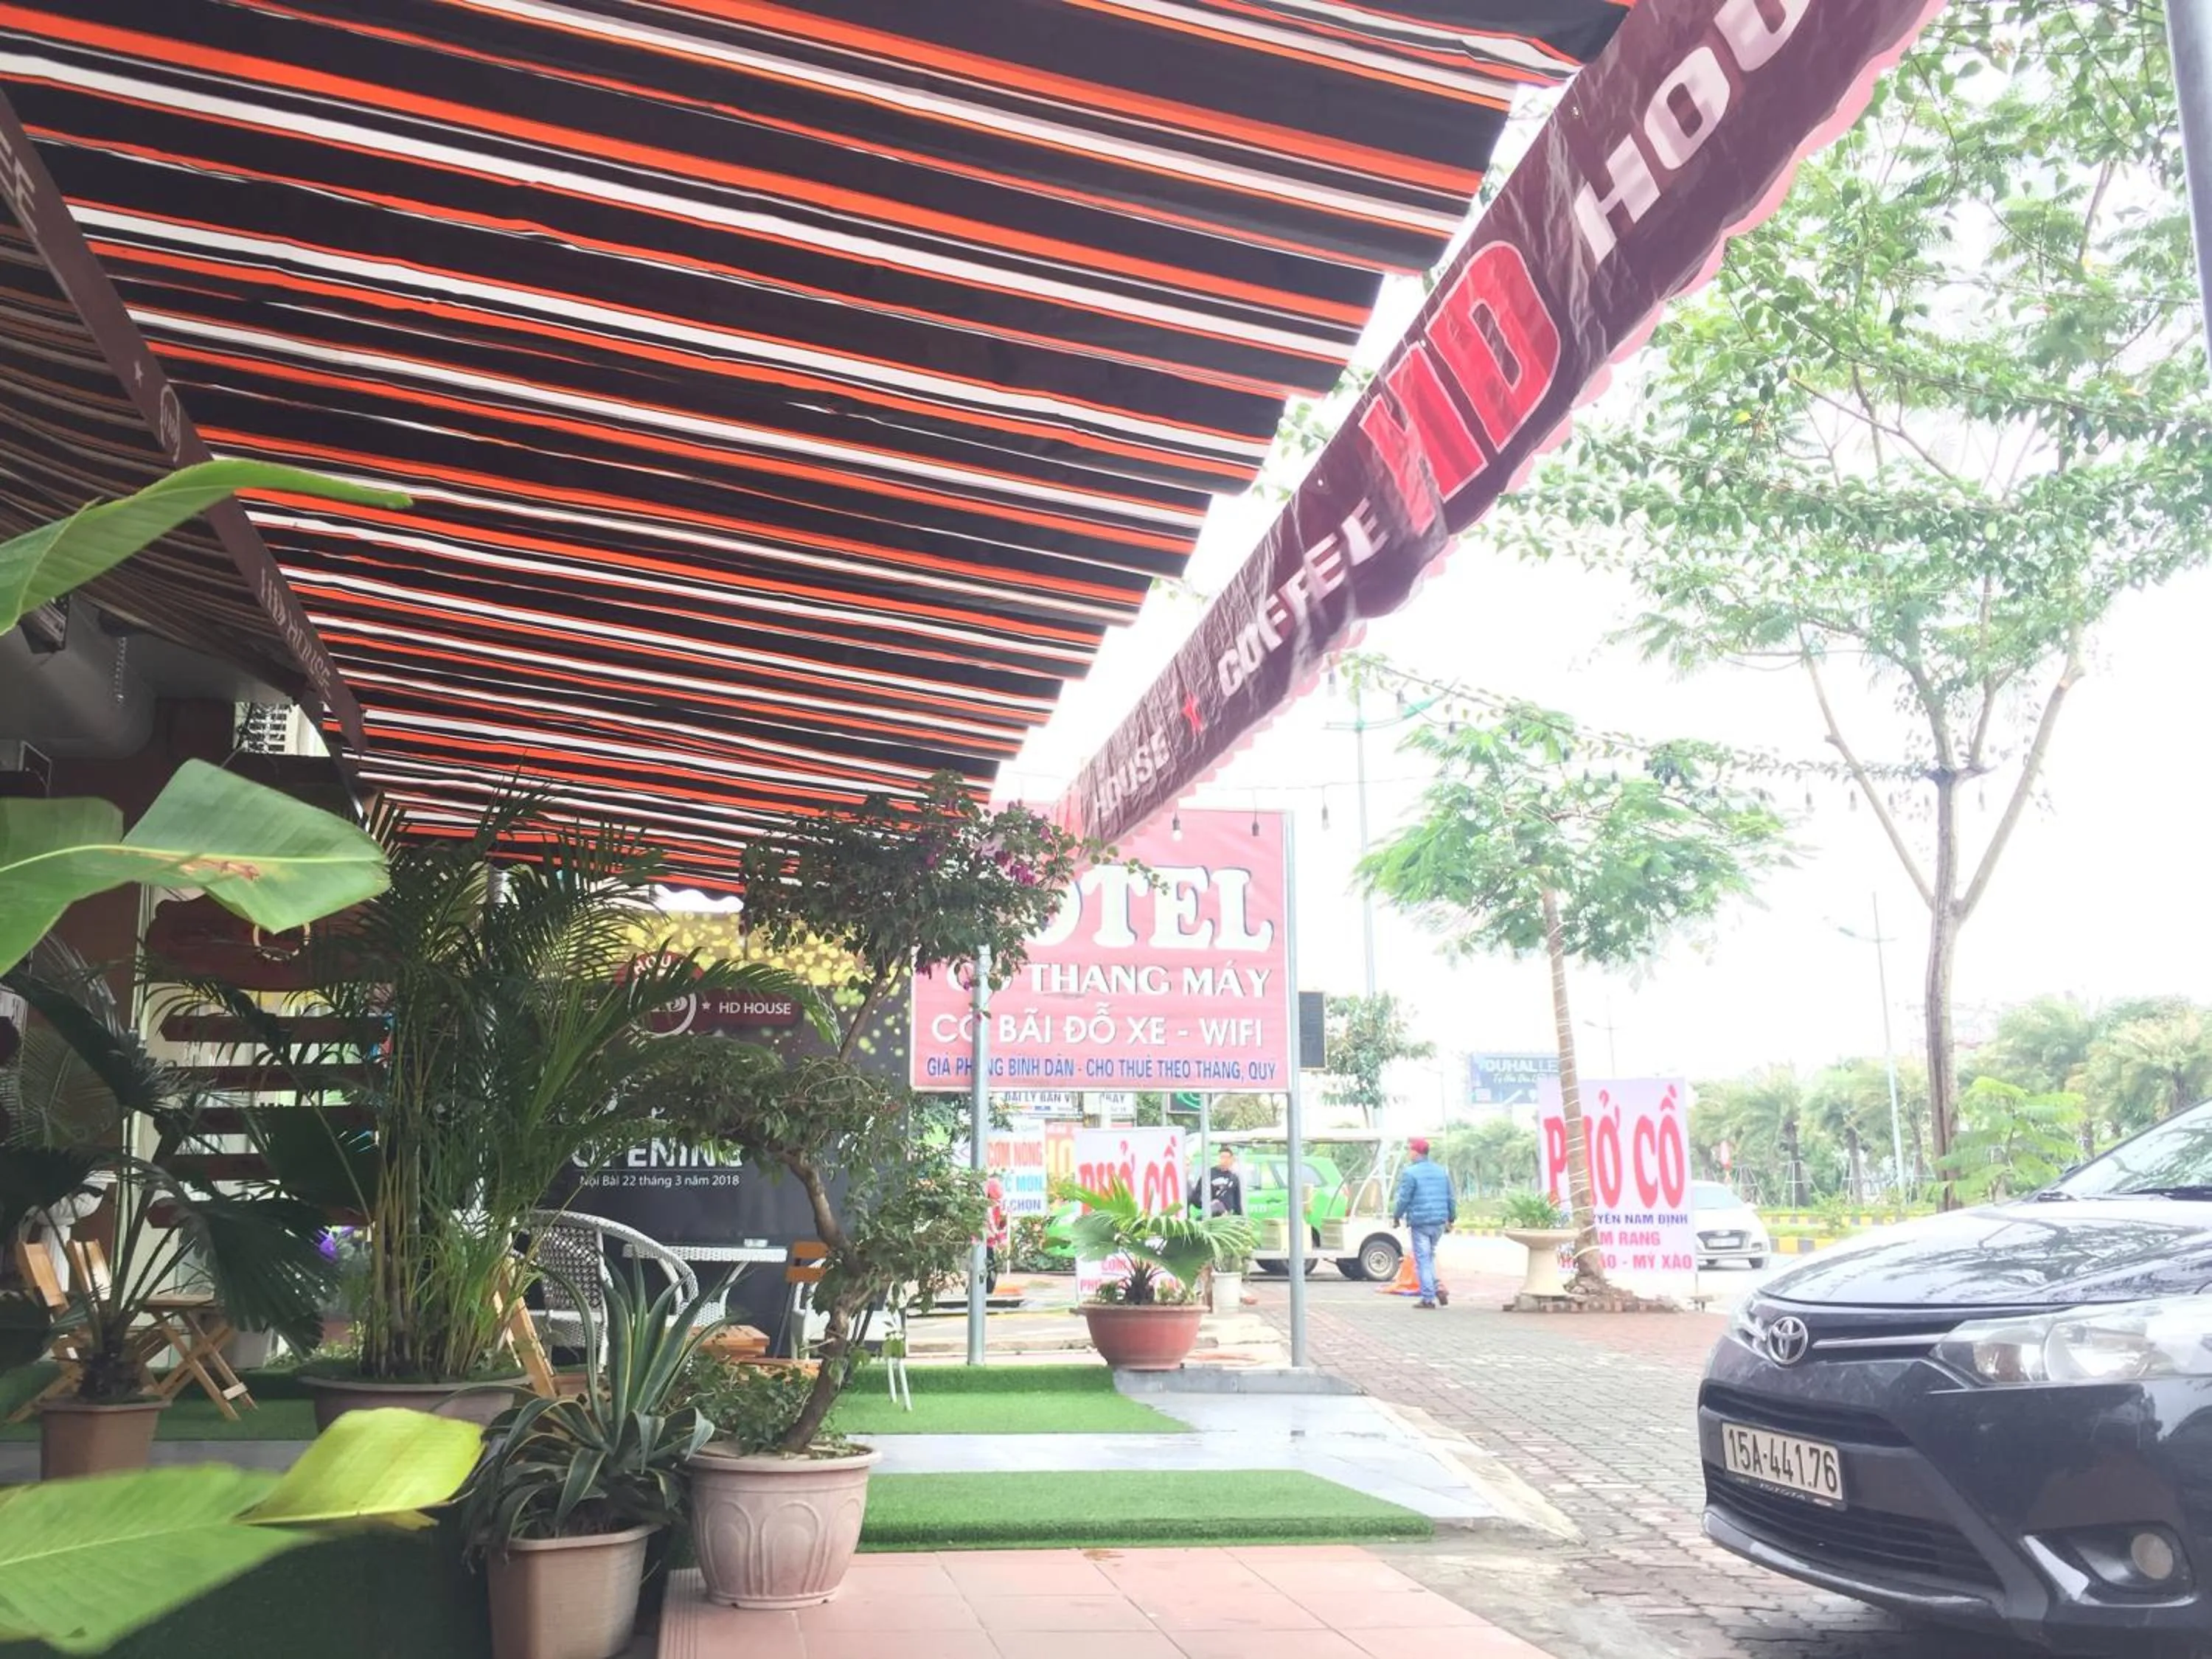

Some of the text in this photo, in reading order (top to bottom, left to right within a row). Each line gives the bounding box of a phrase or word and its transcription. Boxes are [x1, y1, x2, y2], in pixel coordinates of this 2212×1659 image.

[1217, 496, 1391, 697] COFFEE
[1358, 240, 1562, 536] HD
[1025, 864, 1276, 953] OTEL
[1028, 963, 1172, 996] THANG
[1182, 959, 1272, 998] MÁY
[719, 1002, 791, 1015] HD HOUSE
[998, 1007, 1052, 1044] BÃI
[1062, 1001, 1117, 1045] ĐỖ
[1126, 1016, 1168, 1046] XE
[1199, 1018, 1263, 1048] WIFI
[956, 1056, 1004, 1077] PHNG
[1086, 1058, 1115, 1078] CHO
[1157, 1060, 1192, 1079] THEO
[571, 1137, 743, 1168] OENING
[622, 1176, 636, 1186] 22
[639, 1175, 672, 1189] tháng
[675, 1175, 683, 1186] 3
[684, 1175, 709, 1186] năm
[712, 1175, 740, 1186] 2018
[1624, 1214, 1655, 1225] NAM
[1618, 1231, 1661, 1246] RANG
